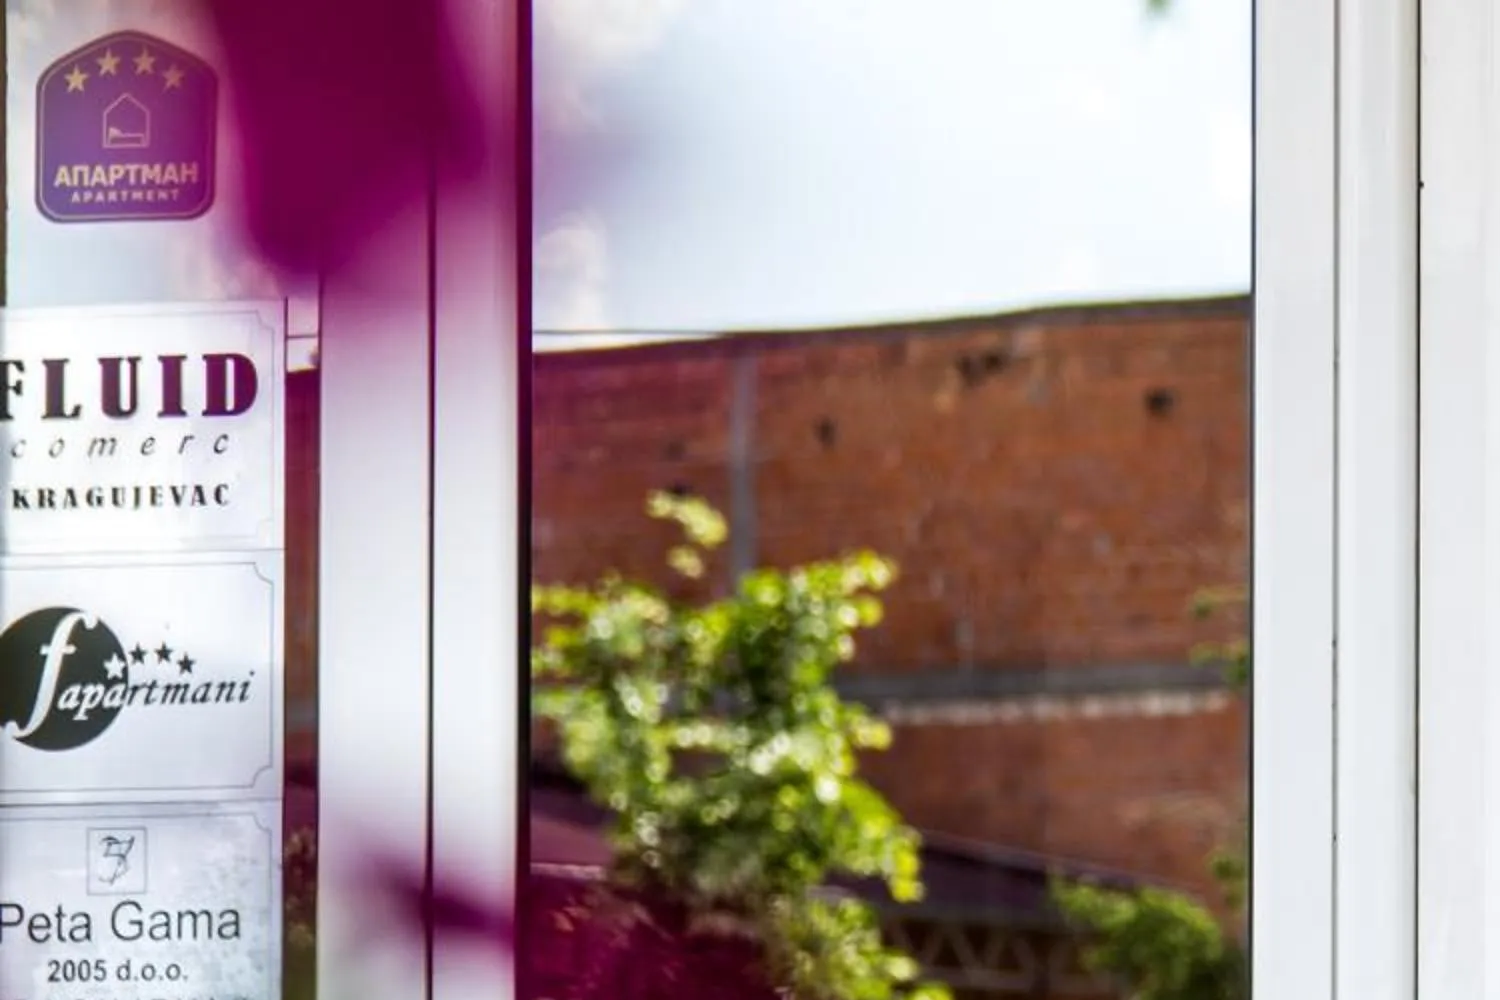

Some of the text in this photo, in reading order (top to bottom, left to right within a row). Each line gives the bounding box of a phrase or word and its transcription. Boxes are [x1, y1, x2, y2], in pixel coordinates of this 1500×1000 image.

[54, 162, 199, 188] АПАРТМАН
[71, 189, 180, 203] APARTMENT
[0, 353, 258, 422] FLUID
[11, 433, 229, 459] comerc
[12, 484, 230, 510] KRAGUJEVAC
[57, 669, 255, 721] apartmani
[0, 900, 241, 943] Peta Gama
[47, 959, 189, 982] 2005 d.o.o.
